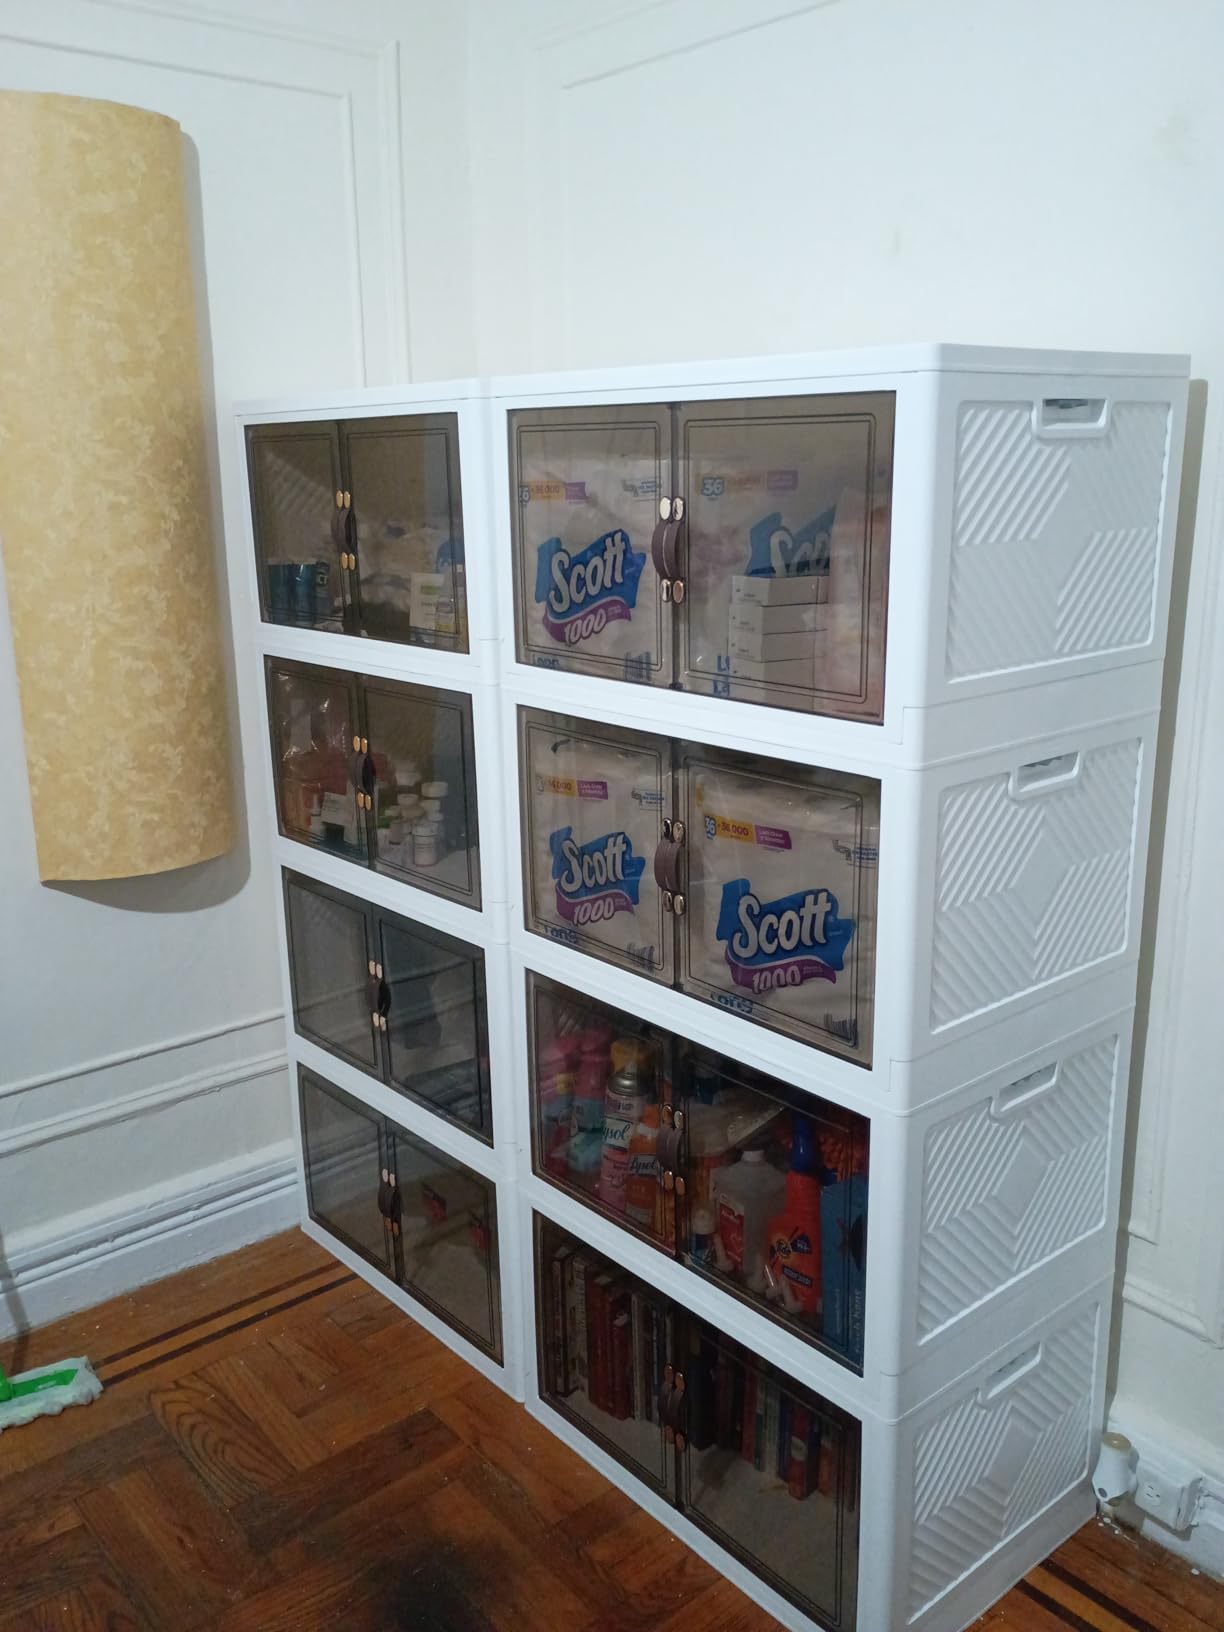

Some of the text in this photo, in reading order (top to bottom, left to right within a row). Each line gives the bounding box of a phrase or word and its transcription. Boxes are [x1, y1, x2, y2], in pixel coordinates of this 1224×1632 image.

[703, 478, 723, 497] 36
[548, 530, 626, 614] Scott
[564, 608, 608, 647] 1000
[560, 833, 628, 893] Scott
[573, 896, 616, 927] 1000
[732, 890, 833, 959] Scott
[751, 965, 802, 994] 1000
[602, 1123, 631, 1142] ysol
